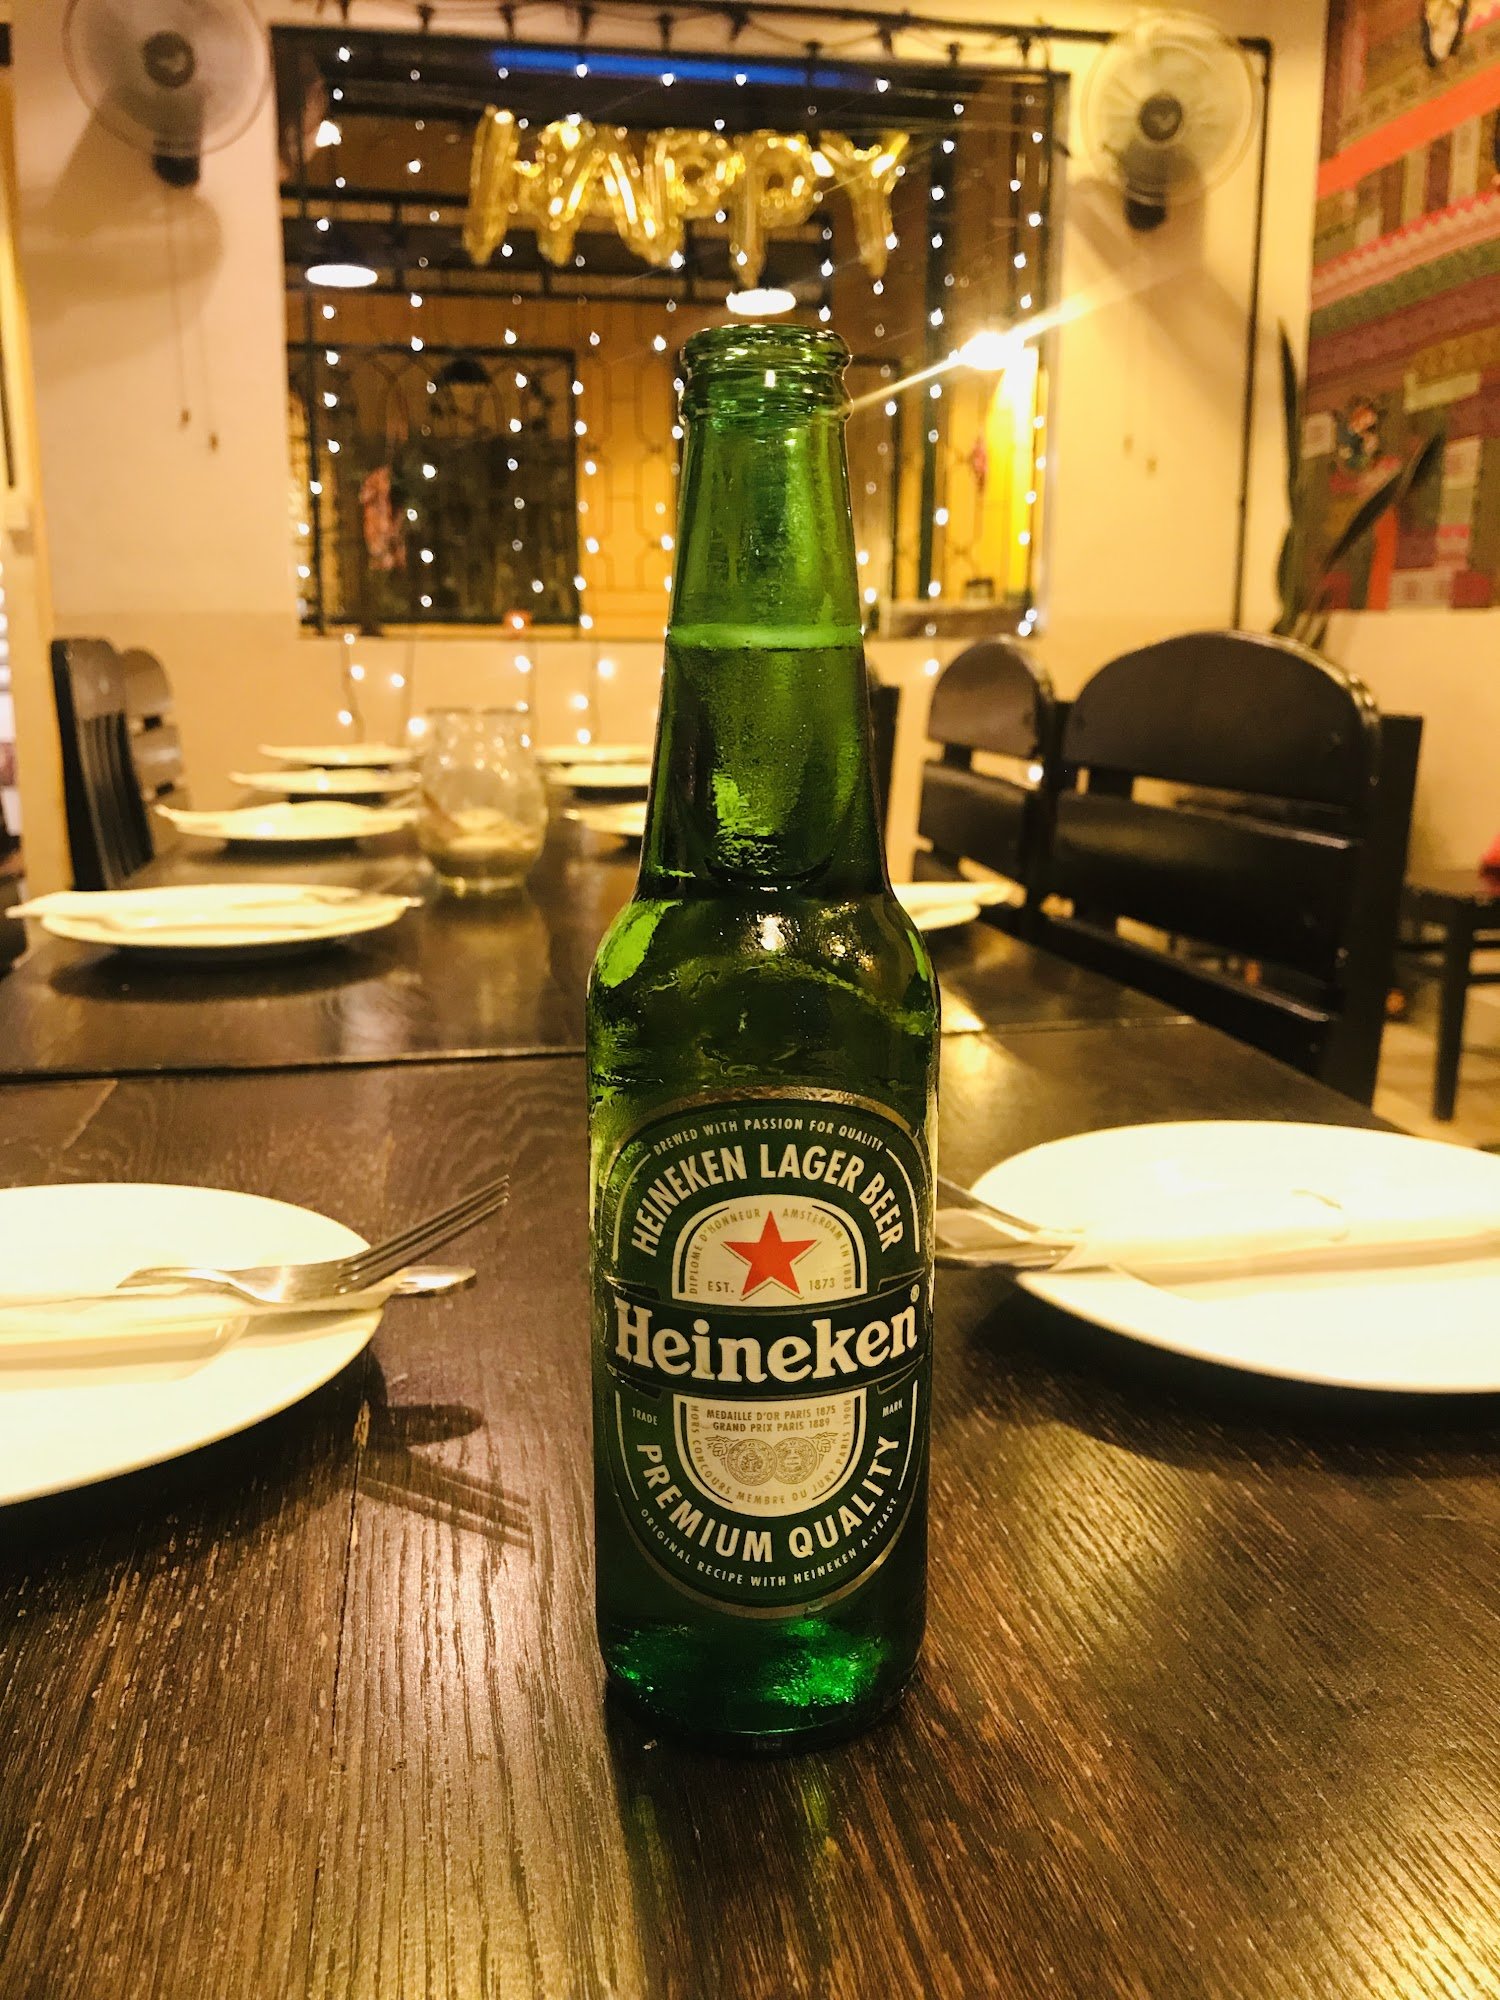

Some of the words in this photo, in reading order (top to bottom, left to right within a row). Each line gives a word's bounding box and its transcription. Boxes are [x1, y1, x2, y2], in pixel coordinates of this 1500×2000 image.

[653, 1128, 698, 1156] BREWED
[702, 1121, 738, 1136] WITH
[744, 1118, 803, 1130] PASSION
[809, 1120, 834, 1134] FOR
[838, 1125, 883, 1151] QUALITY
[631, 1145, 747, 1257] HEINEKEN
[760, 1143, 865, 1193] LAGER
[858, 1171, 904, 1253] BEER
[689, 1244, 703, 1294] DIPLOME
[782, 1208, 844, 1241] AMSTERDAM
[707, 1280, 735, 1294] EST.
[808, 1278, 836, 1292] 1873
[614, 1295, 918, 1383] Heineken
[632, 1407, 658, 1426] TRADE
[690, 1404, 700, 1433] HORS
[706, 1409, 752, 1421] MEDAILLE
[756, 1411, 780, 1421] D'OR
[784, 1409, 811, 1420] PARIS
[816, 1405, 836, 1416] 1875
[882, 1398, 903, 1418] MARK
[713, 1421, 746, 1432] GRAND
[750, 1423, 772, 1432] PRIX
[777, 1421, 804, 1432] PARIS
[809, 1418, 830, 1429] 1889
[835, 1431, 851, 1465] PARIS
[692, 1440, 732, 1495] CONCOURS
[813, 1469, 837, 1492] JURY
[636, 1444, 773, 1563] PREMIUM
[788, 1435, 900, 1558] QUALITY
[736, 1491, 785, 1505] MEMBRE
[641, 1508, 691, 1564] ORIGINAL
[696, 1560, 743, 1585] RECIPE
[750, 1576, 786, 1587] WITH
[793, 1548, 857, 1584] HEINEKEN
[861, 1497, 897, 1549] A-YEAST
